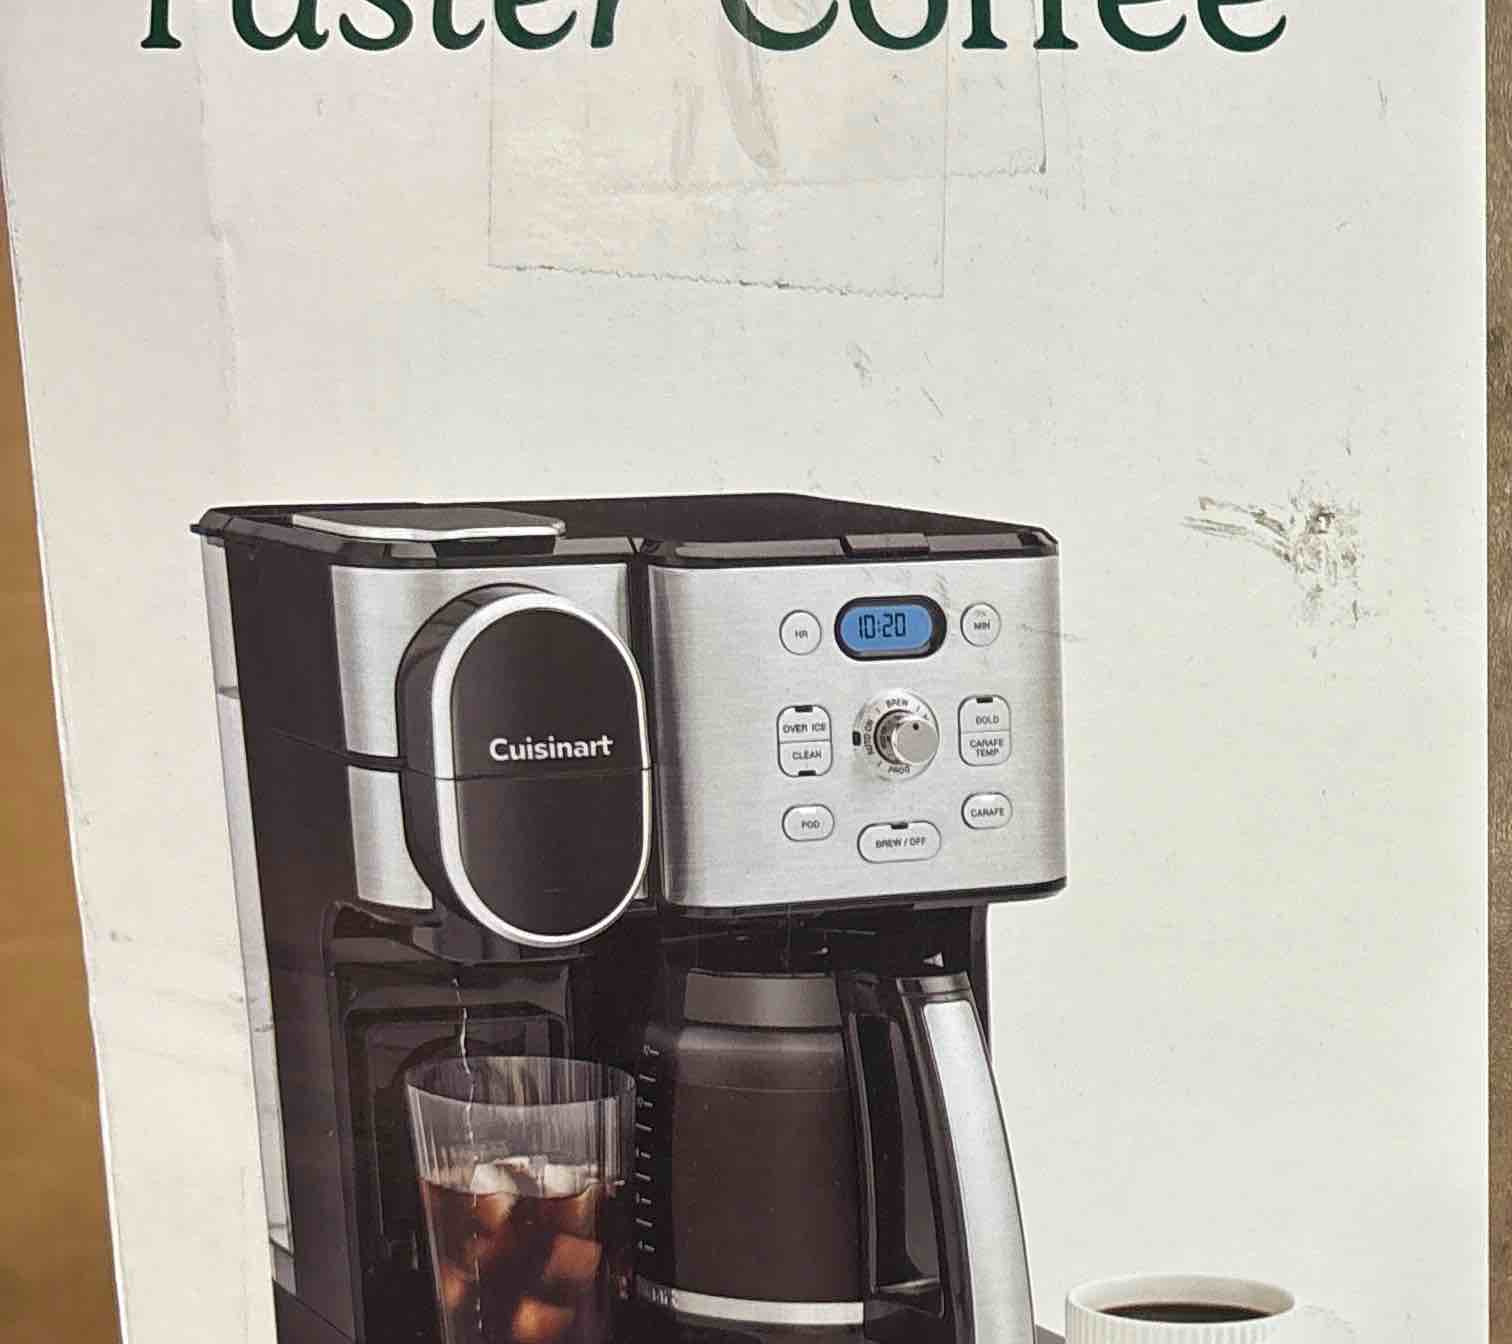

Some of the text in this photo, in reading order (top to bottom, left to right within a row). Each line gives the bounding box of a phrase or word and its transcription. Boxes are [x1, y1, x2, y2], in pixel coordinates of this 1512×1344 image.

[859, 613, 906, 639] 10:20
[973, 620, 991, 631] MIN
[783, 723, 827, 735] OVER ICE
[488, 735, 614, 761] Cuisinart
[969, 738, 1004, 748] CARAFE
[792, 749, 822, 761] CLEAN
[969, 807, 1005, 818] CARAFE
